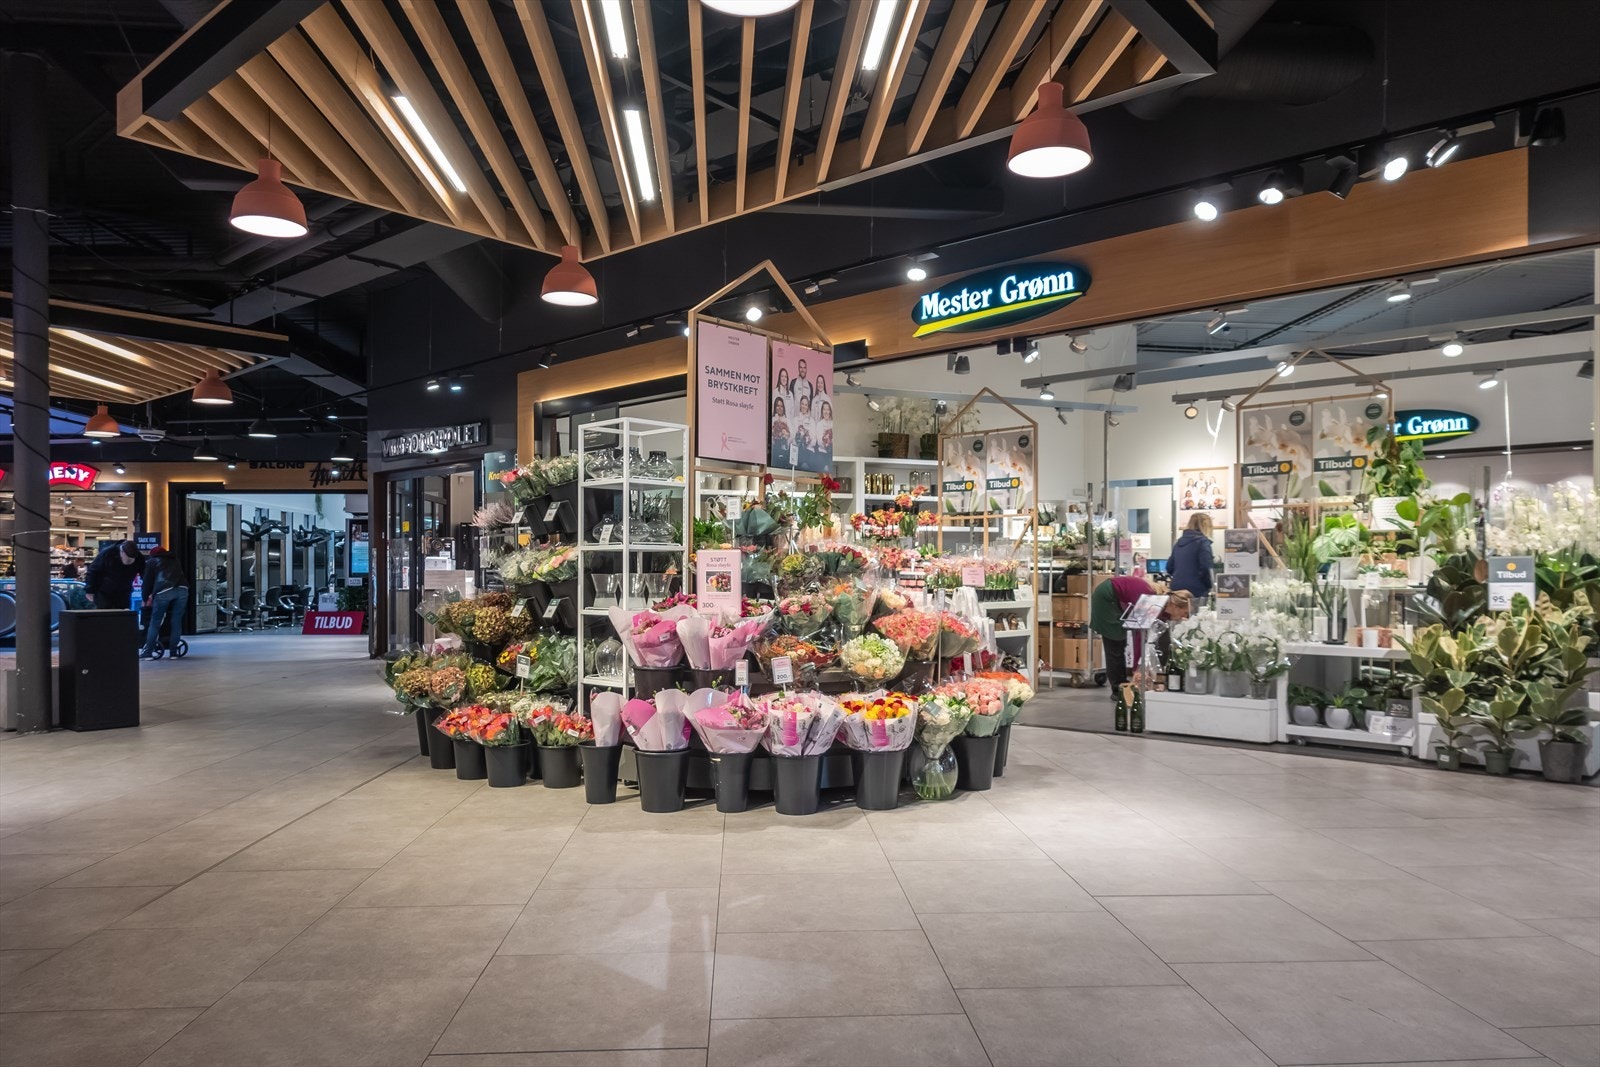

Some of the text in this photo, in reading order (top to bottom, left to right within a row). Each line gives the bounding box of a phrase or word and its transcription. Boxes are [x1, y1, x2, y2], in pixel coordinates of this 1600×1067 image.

[921, 271, 1075, 320] Mester Grønn
[705, 366, 761, 384] SAMMEN MOT
[708, 379, 758, 396] BRYSTKREFT
[712, 397, 754, 410] Støtt Rosa sløyfe
[1407, 416, 1469, 434] Grønn
[249, 461, 305, 469] SALONG
[1247, 464, 1278, 474] Tilbud
[1318, 459, 1353, 469] Tilbud
[945, 483, 966, 491] Tilbud
[989, 480, 1011, 488] Tilbud
[314, 616, 353, 629] TILBUD
